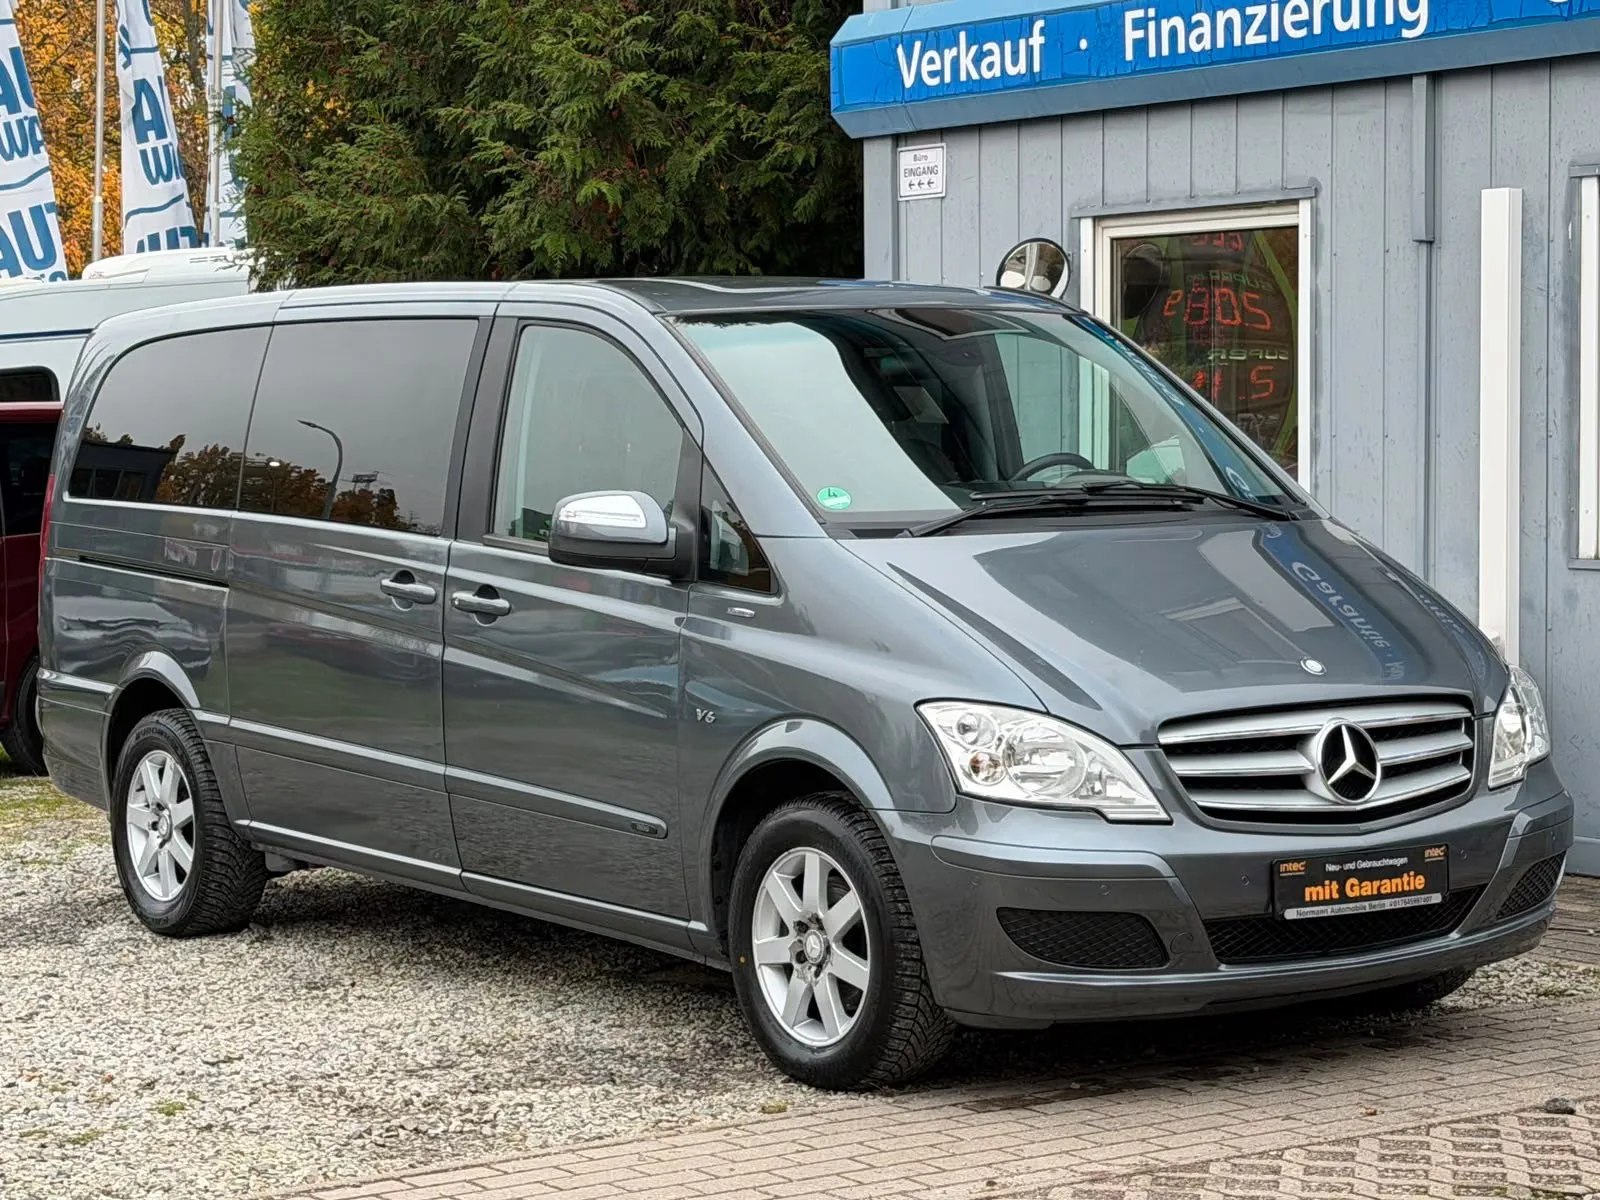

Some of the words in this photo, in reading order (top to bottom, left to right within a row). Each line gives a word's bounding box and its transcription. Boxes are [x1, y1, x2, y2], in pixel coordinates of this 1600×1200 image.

[897, 19, 1046, 89] Verkauf
[1124, 0, 1428, 61] Finanzierung
[903, 164, 939, 178] EINGANG
[696, 708, 716, 724] V6
[1280, 861, 1306, 873] intec
[1343, 861, 1355, 870] und
[1356, 857, 1408, 869] Gebrauchtwagen
[1305, 880, 1340, 902] mit
[1345, 871, 1426, 898] Garantie
[1330, 902, 1367, 914] Automobile
